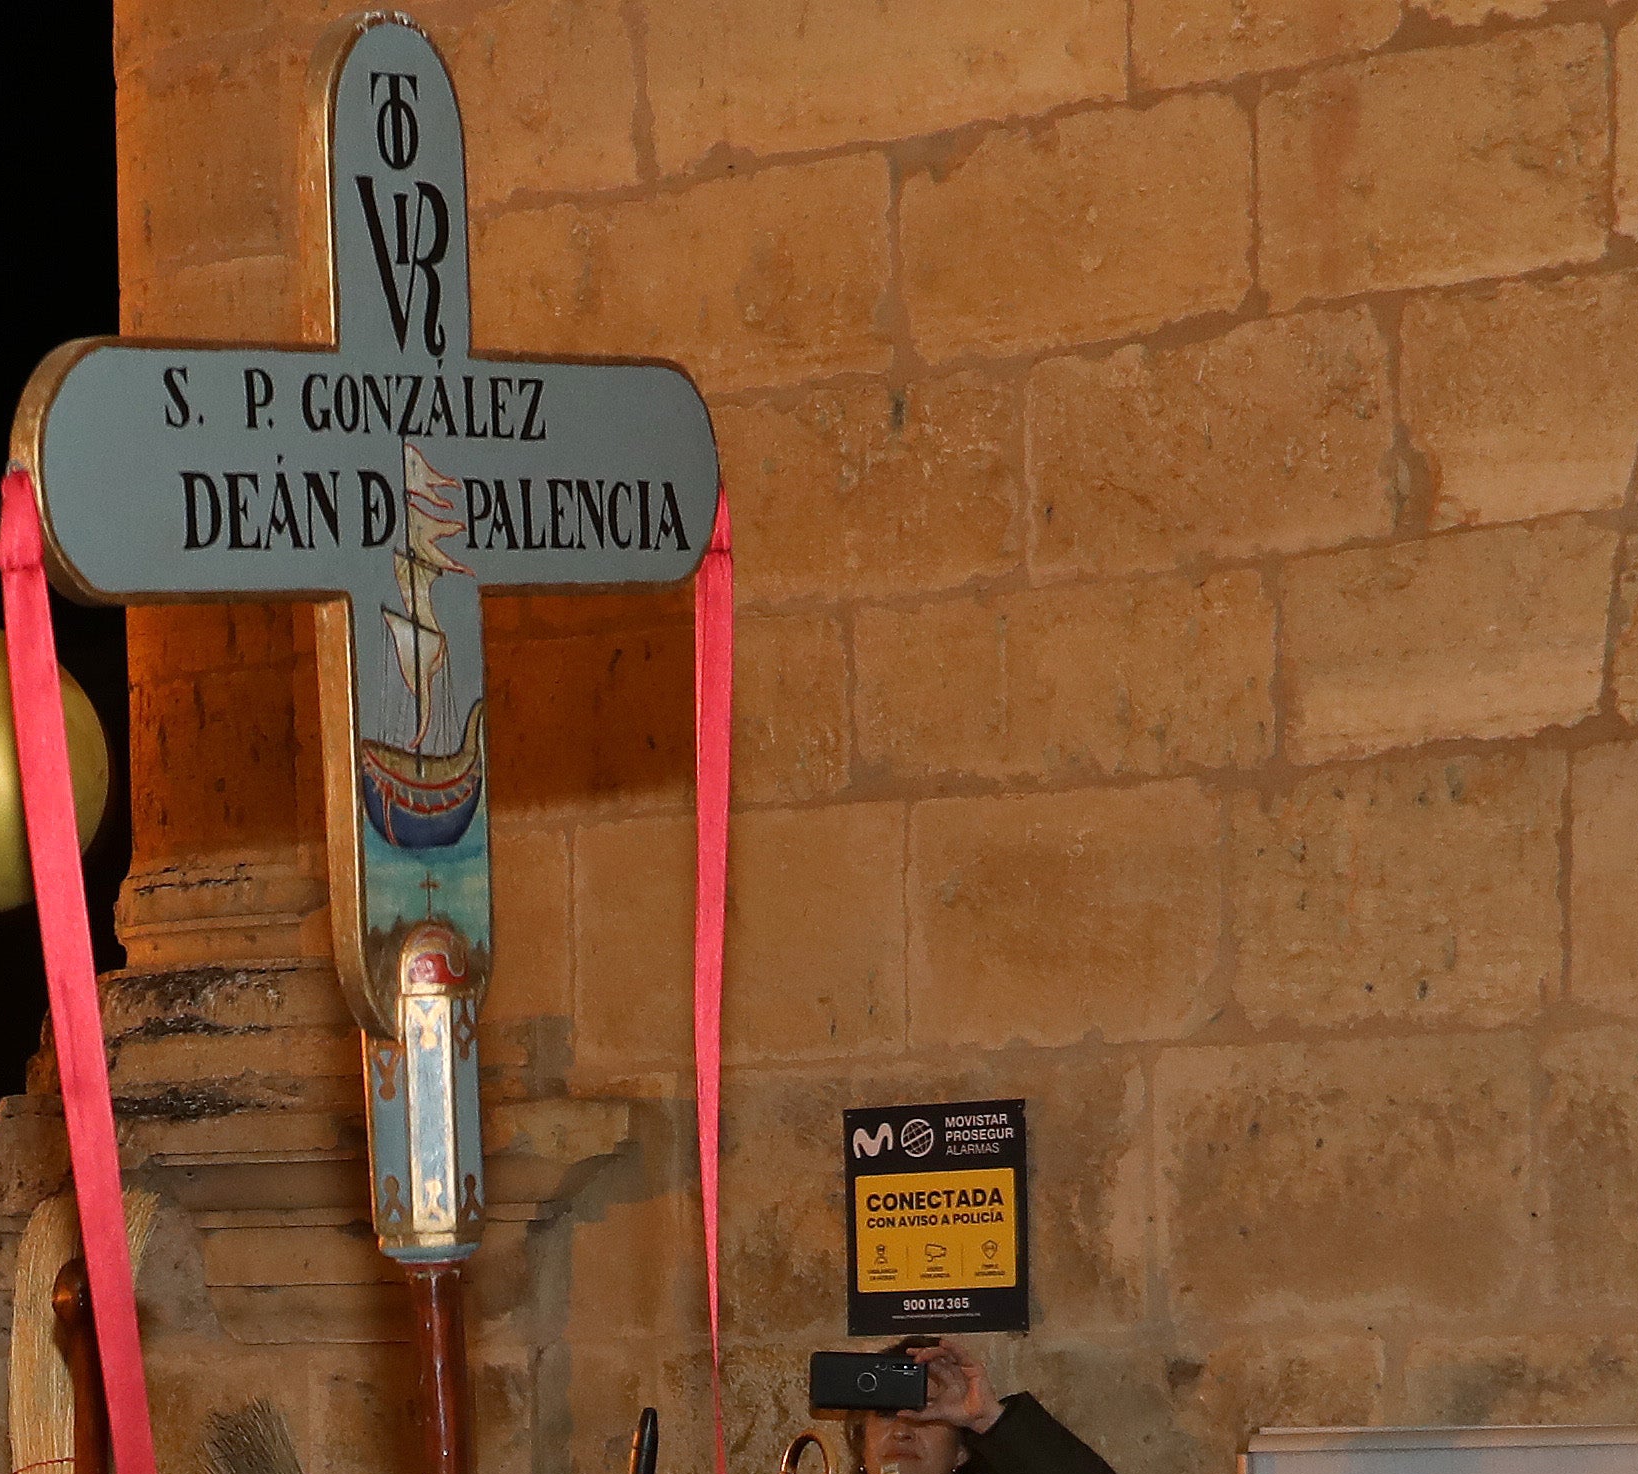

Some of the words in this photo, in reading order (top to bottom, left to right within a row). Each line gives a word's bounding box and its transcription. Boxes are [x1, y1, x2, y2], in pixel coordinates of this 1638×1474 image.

[164, 368, 205, 429] S.
[244, 369, 275, 430] P.
[301, 357, 549, 443] GONZÁLEZ
[182, 453, 343, 552] DEÁN
[461, 477, 691, 552] PALENCIA
[944, 1113, 1009, 1128] MOVISTAR
[945, 1127, 1014, 1142] PROSEGUR
[945, 1142, 1000, 1155] ALARMAS
[866, 1187, 1005, 1213] CONECTADA
[866, 1217, 896, 1229] CON
[897, 1214, 938, 1227] AVISO
[941, 1214, 951, 1225] A
[952, 1208, 1005, 1224] POLICÍA
[903, 1299, 926, 1311] 900
[928, 1298, 945, 1310] 112
[946, 1297, 970, 1309] 365
